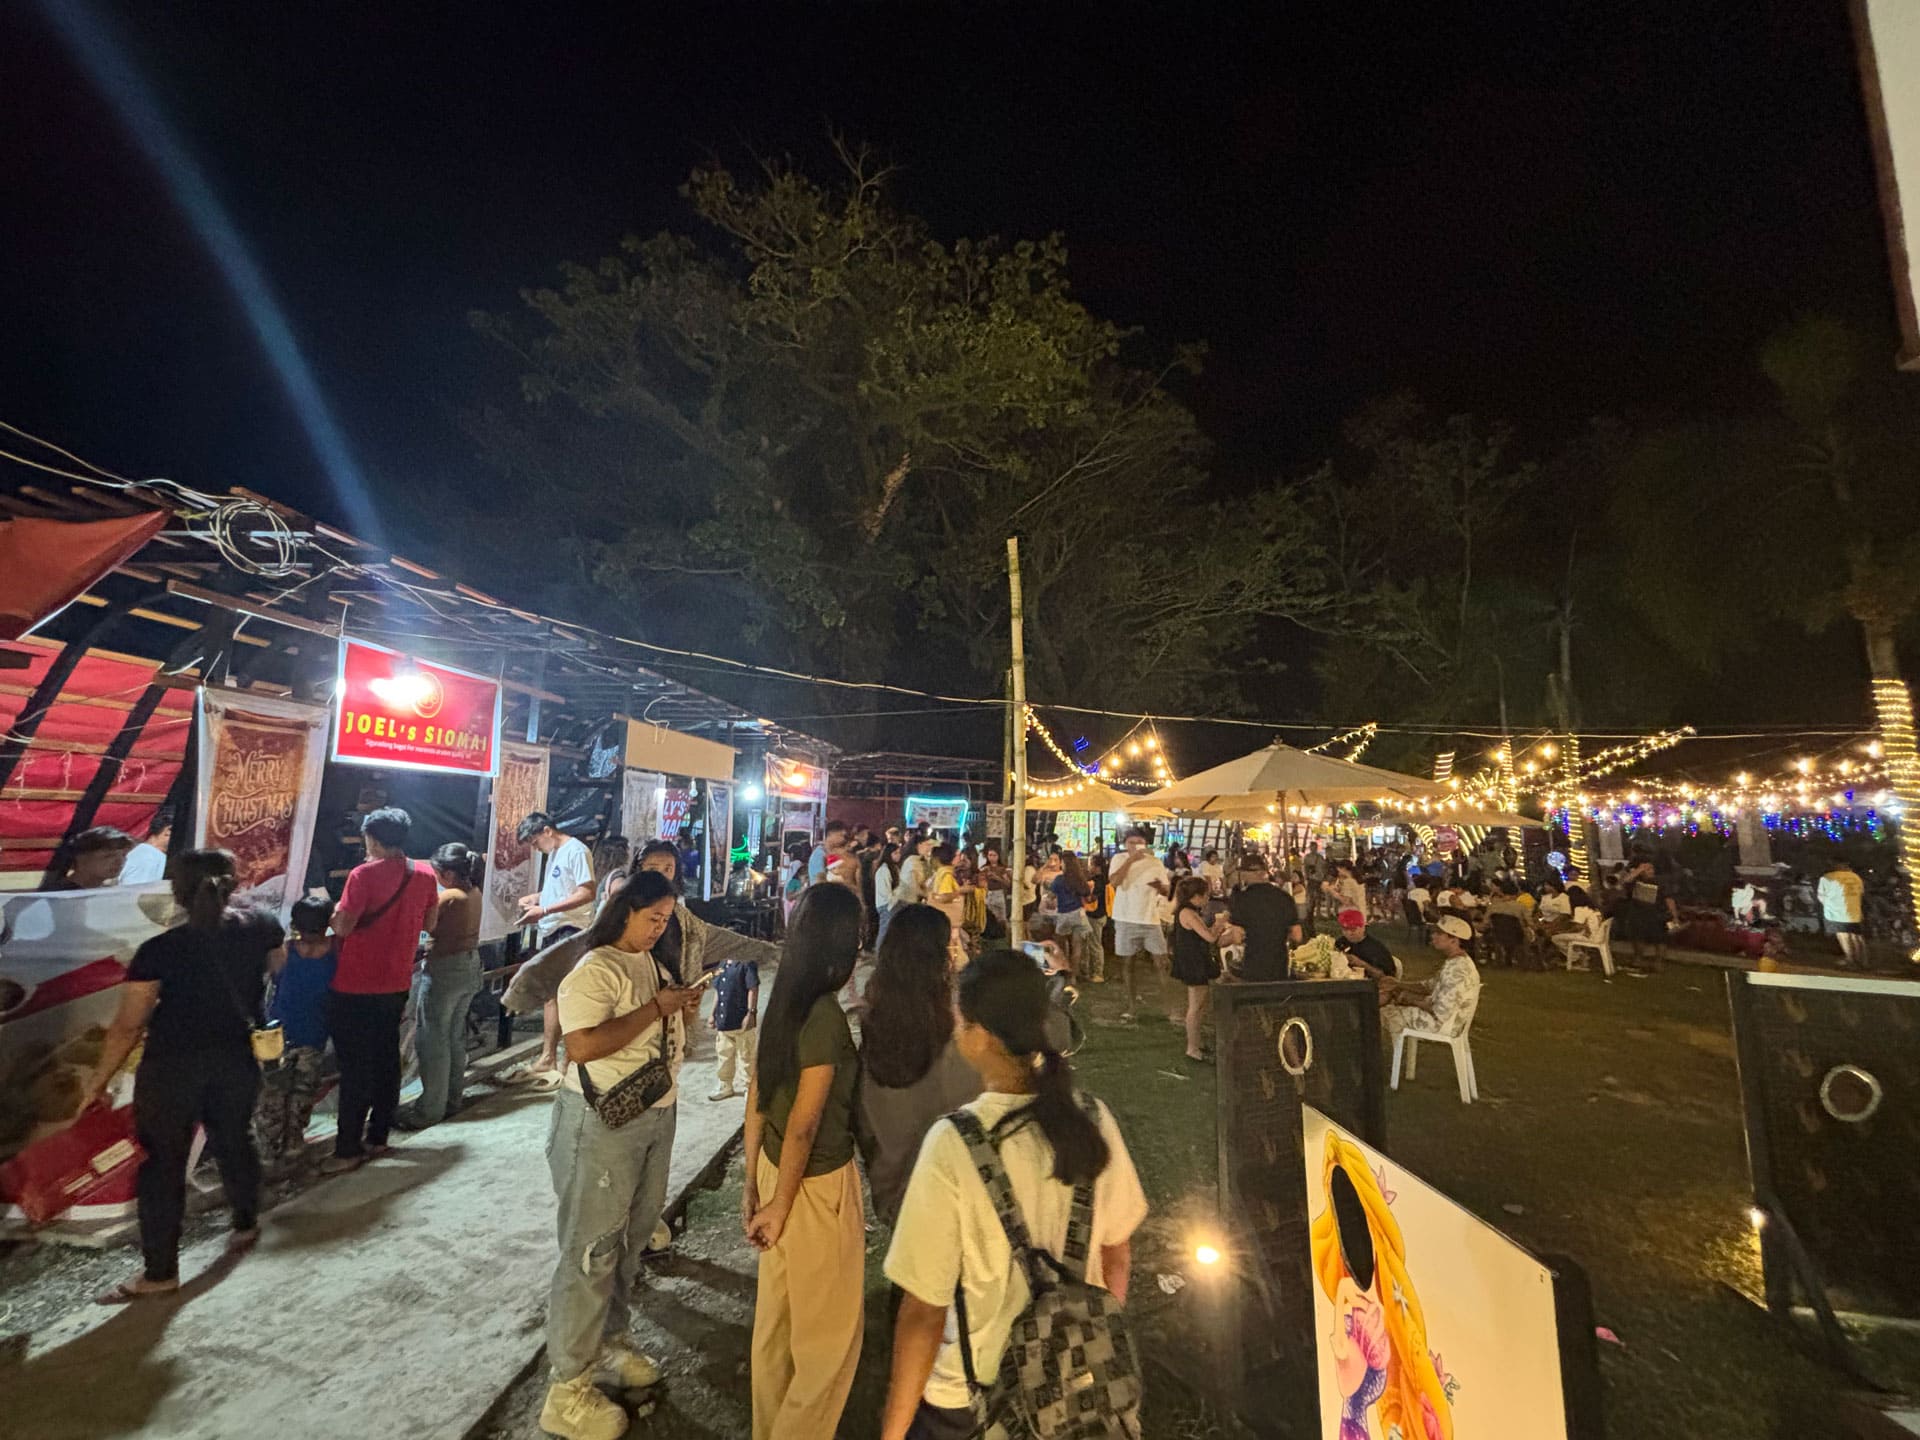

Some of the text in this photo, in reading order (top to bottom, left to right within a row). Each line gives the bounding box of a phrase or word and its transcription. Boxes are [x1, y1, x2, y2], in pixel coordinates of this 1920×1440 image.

[345, 711, 487, 752] JOEL's SIOMAI
[225, 750, 289, 792] MERRY
[212, 791, 293, 838] CHRISTMAS
